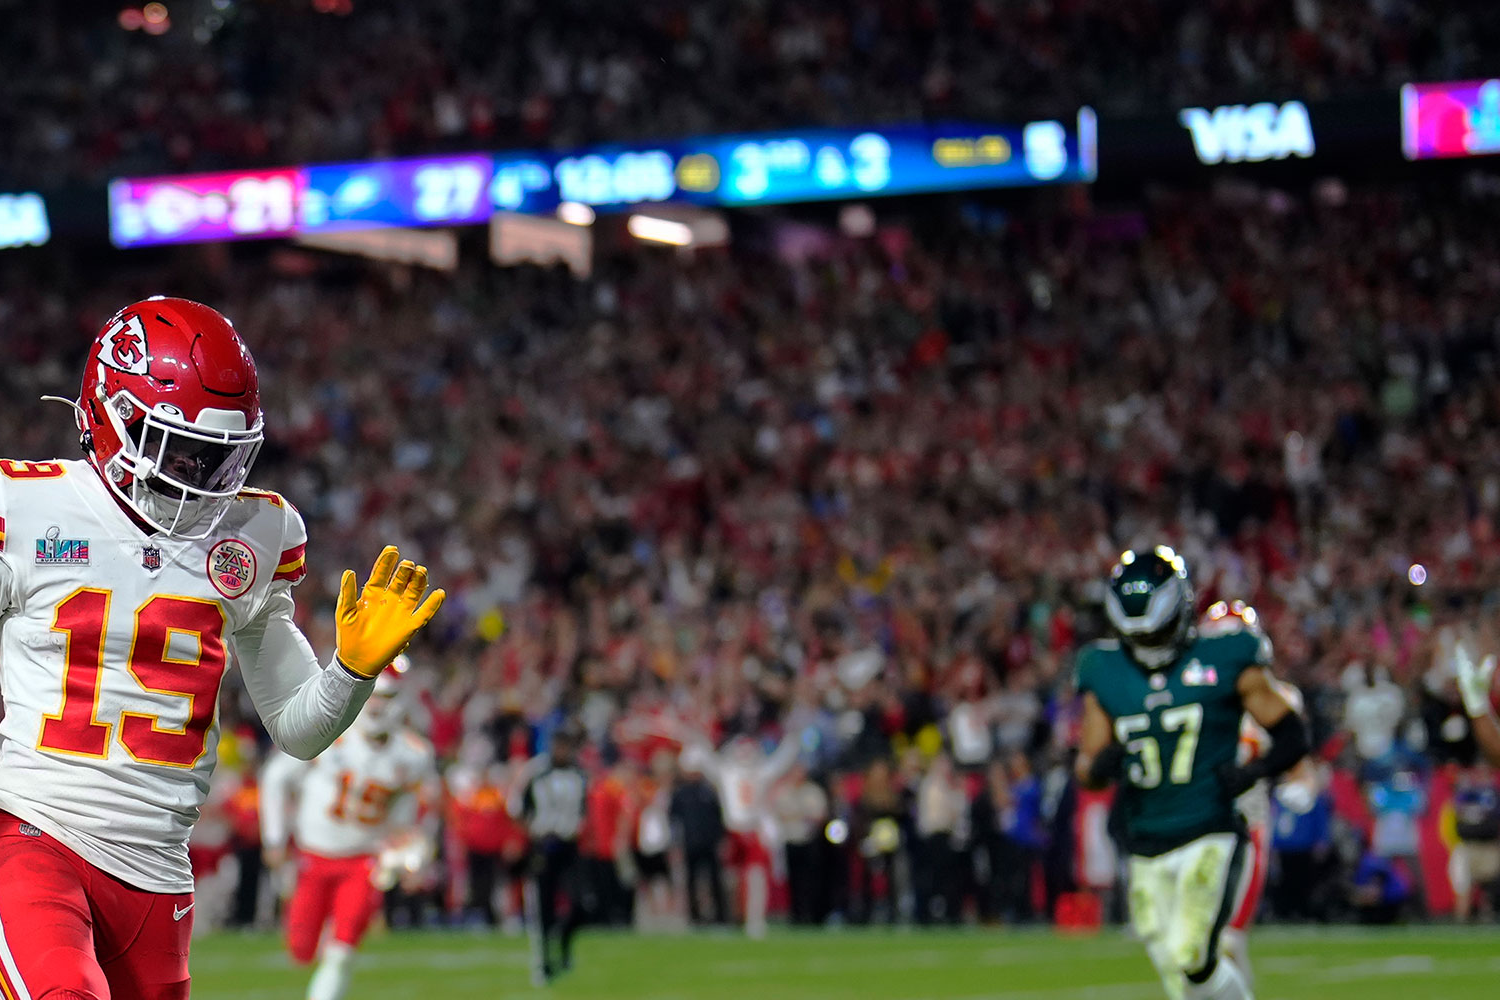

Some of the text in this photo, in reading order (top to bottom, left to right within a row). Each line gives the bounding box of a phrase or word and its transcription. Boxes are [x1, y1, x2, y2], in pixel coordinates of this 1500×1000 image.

[1180, 102, 1314, 164] VISA
[36, 586, 228, 769] 19
[1115, 703, 1203, 789] 57
